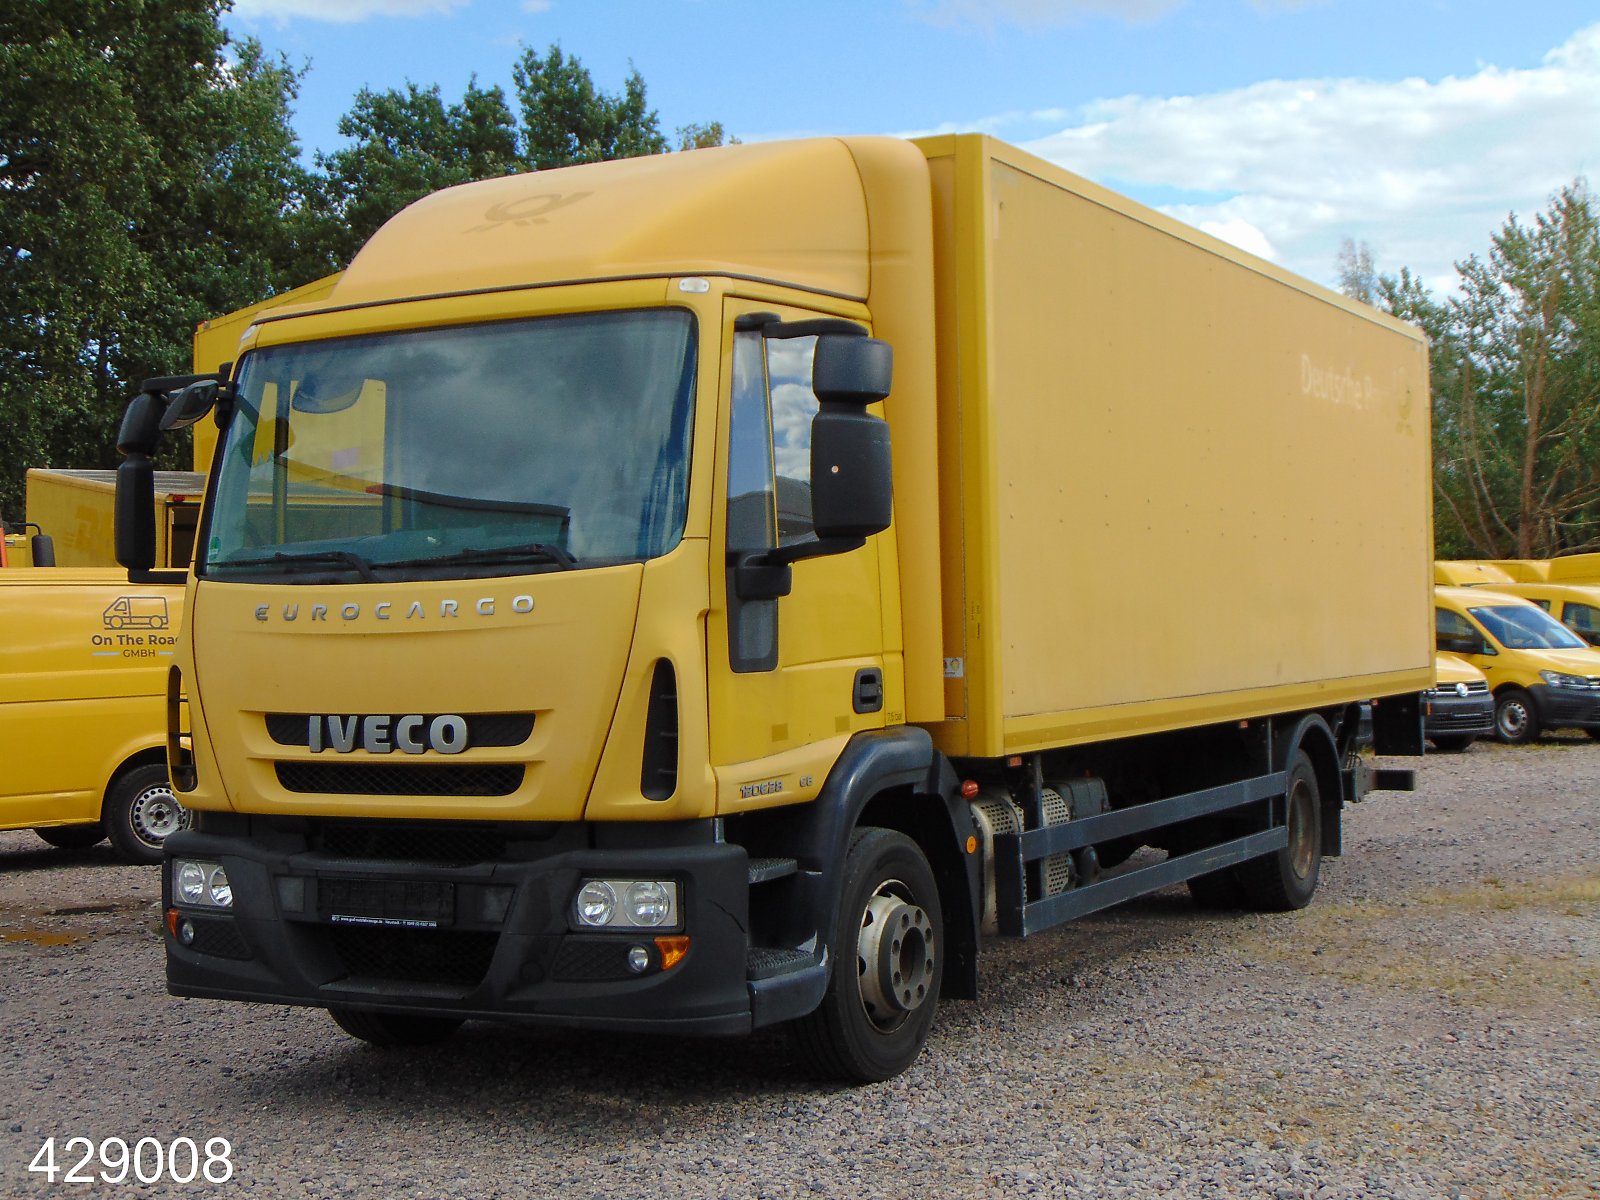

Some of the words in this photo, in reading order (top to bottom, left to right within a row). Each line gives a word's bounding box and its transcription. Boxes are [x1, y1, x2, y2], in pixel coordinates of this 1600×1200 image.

[255, 595, 535, 621] EUROCARGO
[91, 634, 113, 646] On
[116, 634, 144, 646] The
[122, 649, 156, 658] GMBH
[308, 714, 468, 754] IVECO
